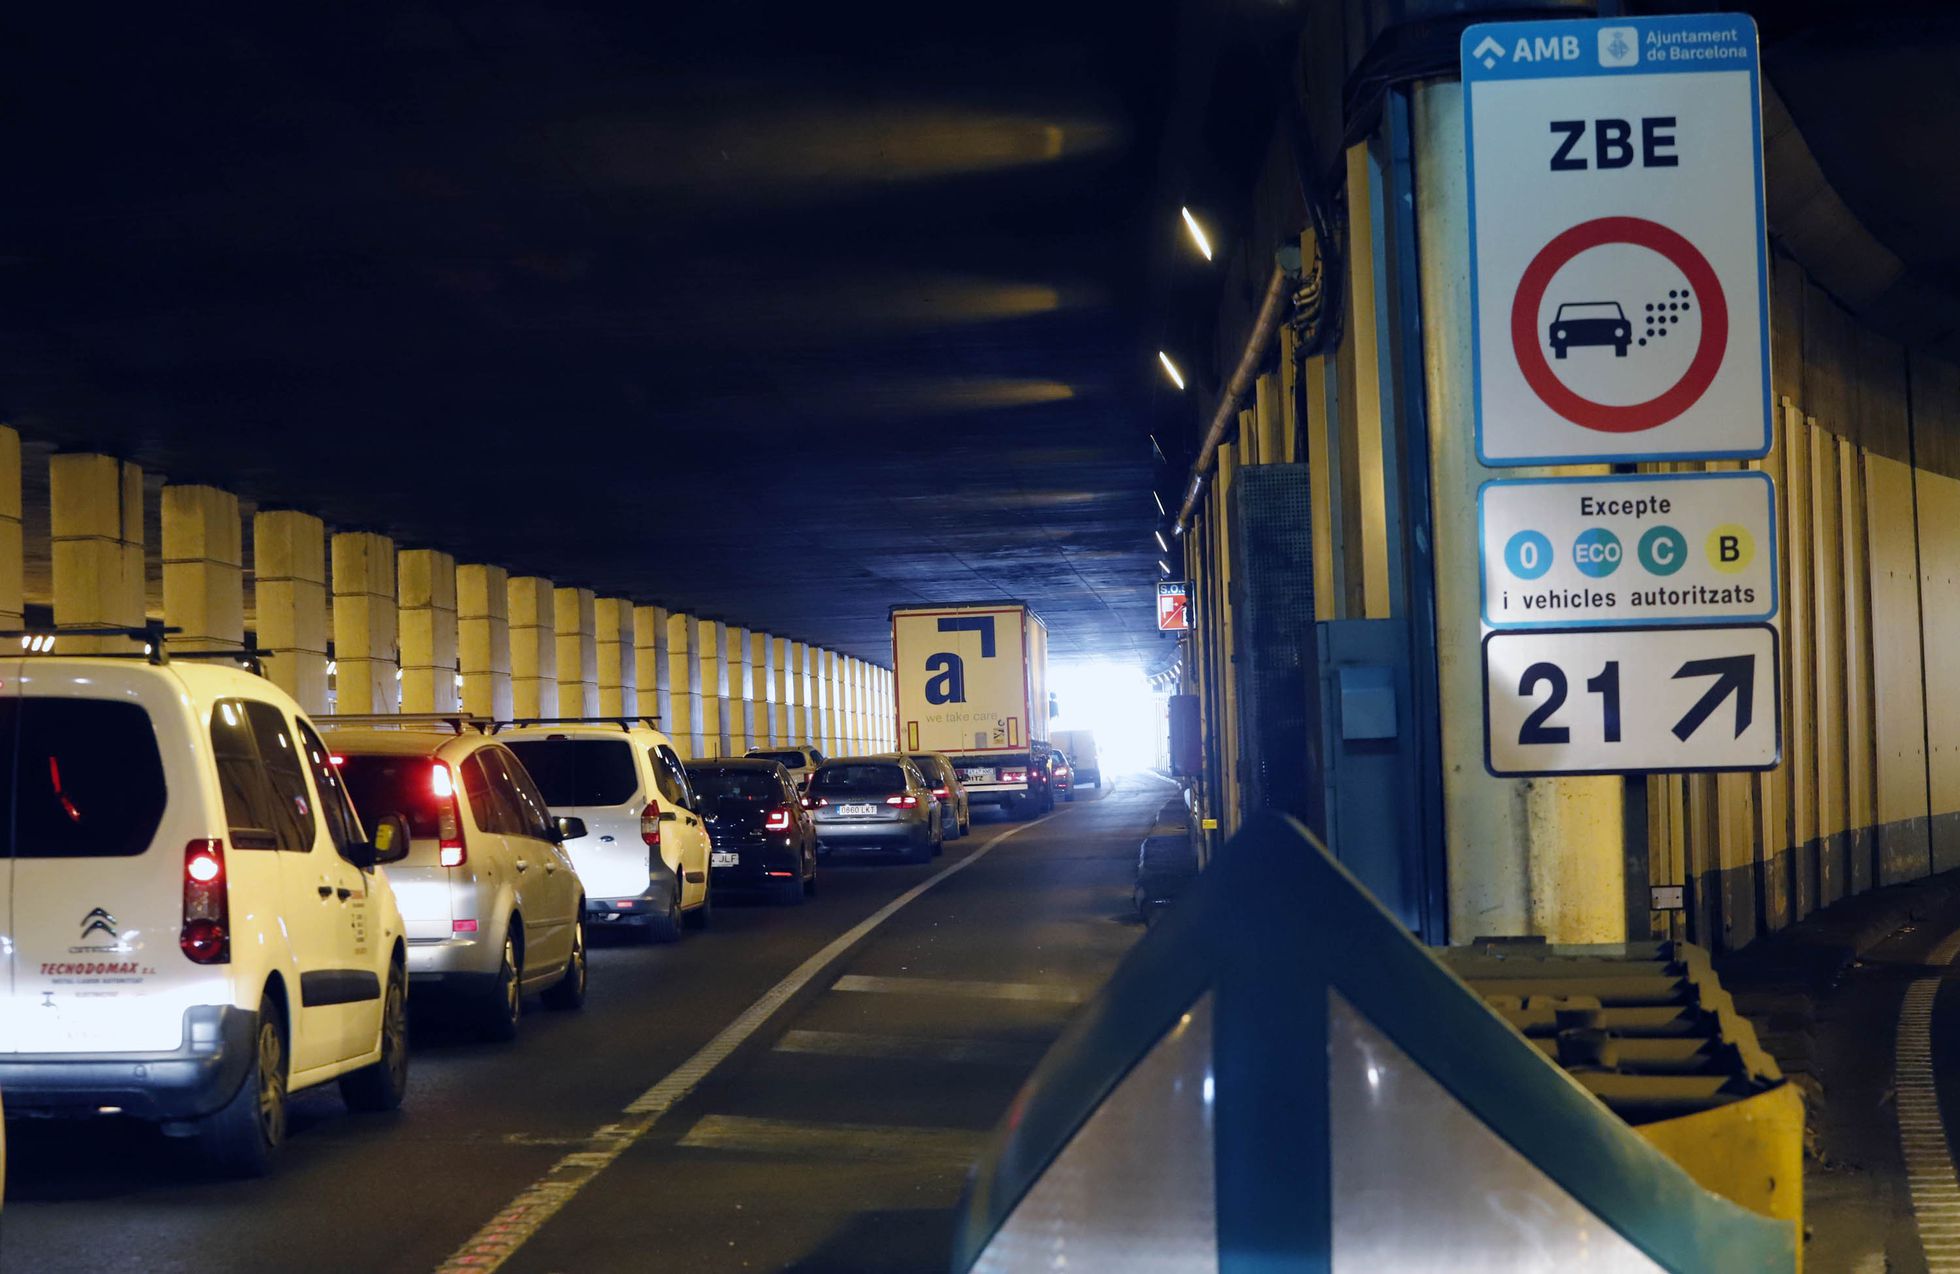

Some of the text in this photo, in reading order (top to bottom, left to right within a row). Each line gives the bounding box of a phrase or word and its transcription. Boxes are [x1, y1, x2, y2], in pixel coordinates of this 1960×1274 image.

[1512, 36, 1580, 62] AMB
[1646, 29, 1738, 47] Ajuntament
[1647, 45, 1748, 61] de Barcelona
[1549, 116, 1679, 171] ZBE
[1580, 496, 1672, 518] Excepte
[1575, 543, 1621, 563] ECO
[1651, 537, 1674, 565] C
[1719, 535, 1740, 562] B
[1503, 585, 1755, 610] i vehicles autoritzats
[925, 652, 967, 705] a
[1518, 661, 1622, 745] 21
[926, 711, 998, 723] we take care
[861, 806, 875, 814] LKT
[719, 854, 737, 863] JLF
[40, 962, 139, 975] TECNODOMAX
